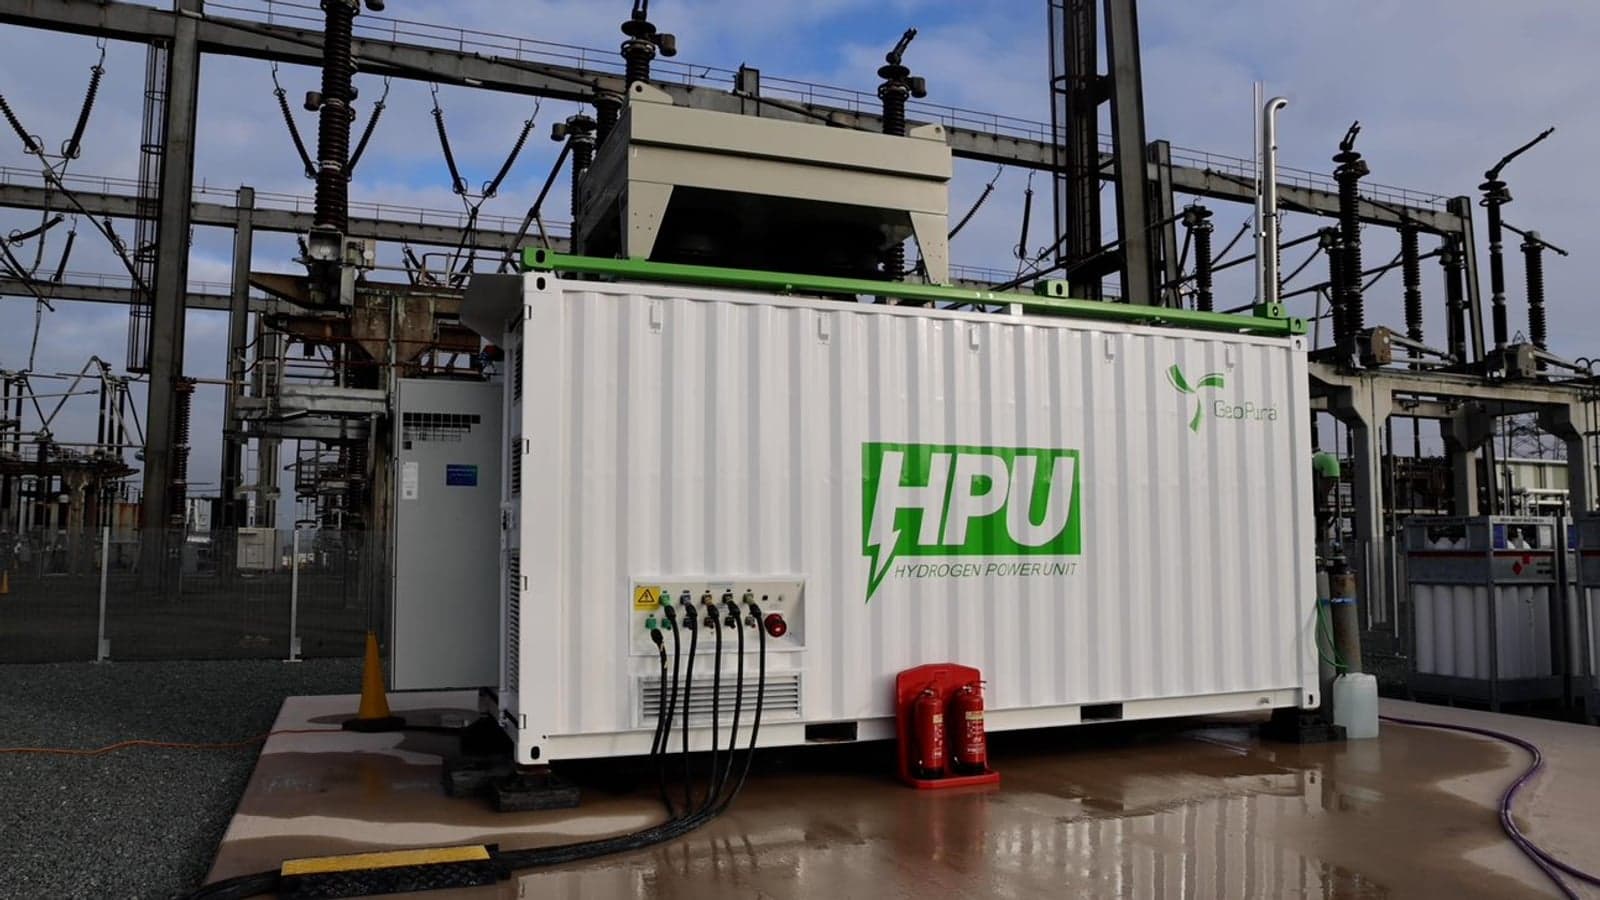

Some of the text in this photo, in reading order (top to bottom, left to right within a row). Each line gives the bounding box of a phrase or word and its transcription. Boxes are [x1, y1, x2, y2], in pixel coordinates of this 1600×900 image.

[1214, 400, 1277, 421] GeoPura
[867, 450, 1076, 548] HPU
[894, 562, 1078, 578] HYDROGEN POWER UNIT
